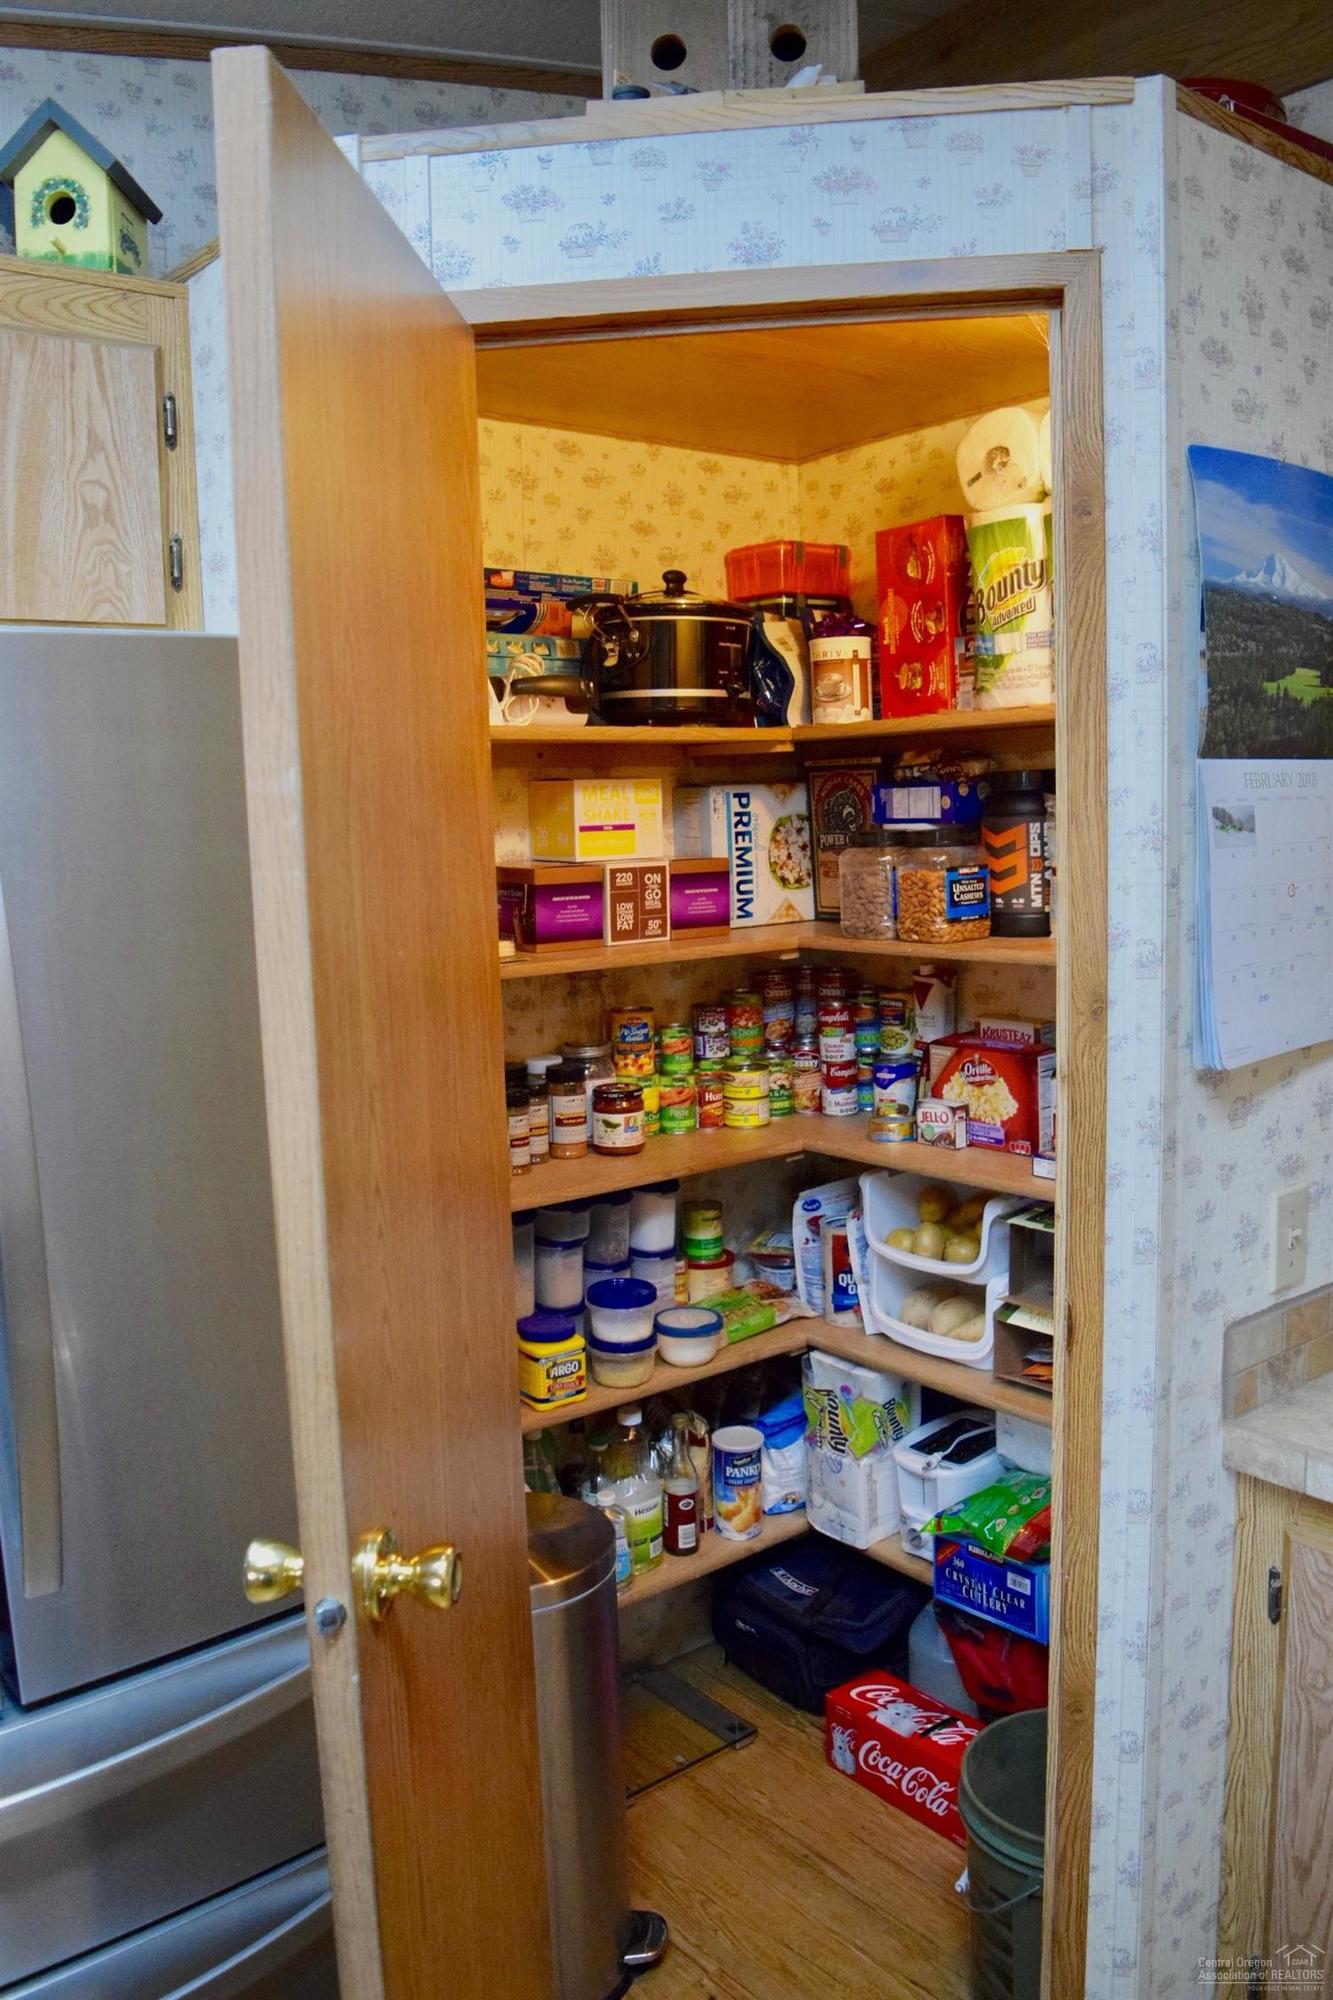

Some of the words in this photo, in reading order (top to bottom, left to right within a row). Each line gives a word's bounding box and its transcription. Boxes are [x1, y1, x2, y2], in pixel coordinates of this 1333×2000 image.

[975, 559, 1047, 625] Bounty
[992, 598, 1033, 628] Advanced
[1243, 771, 1294, 789] FEBRUARY
[583, 785, 630, 802] MEAL
[583, 808, 631, 822] SHAKE
[819, 833, 845, 849] POWER
[1029, 822, 1042, 857] OPS
[732, 791, 754, 920] PREMIUM
[615, 872, 633, 882] 220
[644, 873, 661, 884] ON
[645, 889, 661, 900] GO
[952, 881, 985, 893] UNSALTED
[1030, 873, 1043, 908] MTN
[953, 891, 984, 902] CASHEWS
[616, 902, 634, 910] LOW
[616, 913, 634, 921] LOW
[616, 921, 634, 931] FAT
[981, 1025, 1032, 1044] KRUSTEAZ
[964, 1061, 992, 1078] Orville
[549, 1360, 580, 1379] ARGO
[816, 1388, 850, 1455] Bounty
[881, 1396, 905, 1442] Bounty
[967, 1543, 1005, 1565] KIRKLAND
[945, 1566, 988, 1595] CRYSTAL
[992, 1585, 1026, 1610] CLEAR
[961, 1583, 1009, 1615] CUTLERY
[858, 1739, 957, 1817] Coca-Cola
